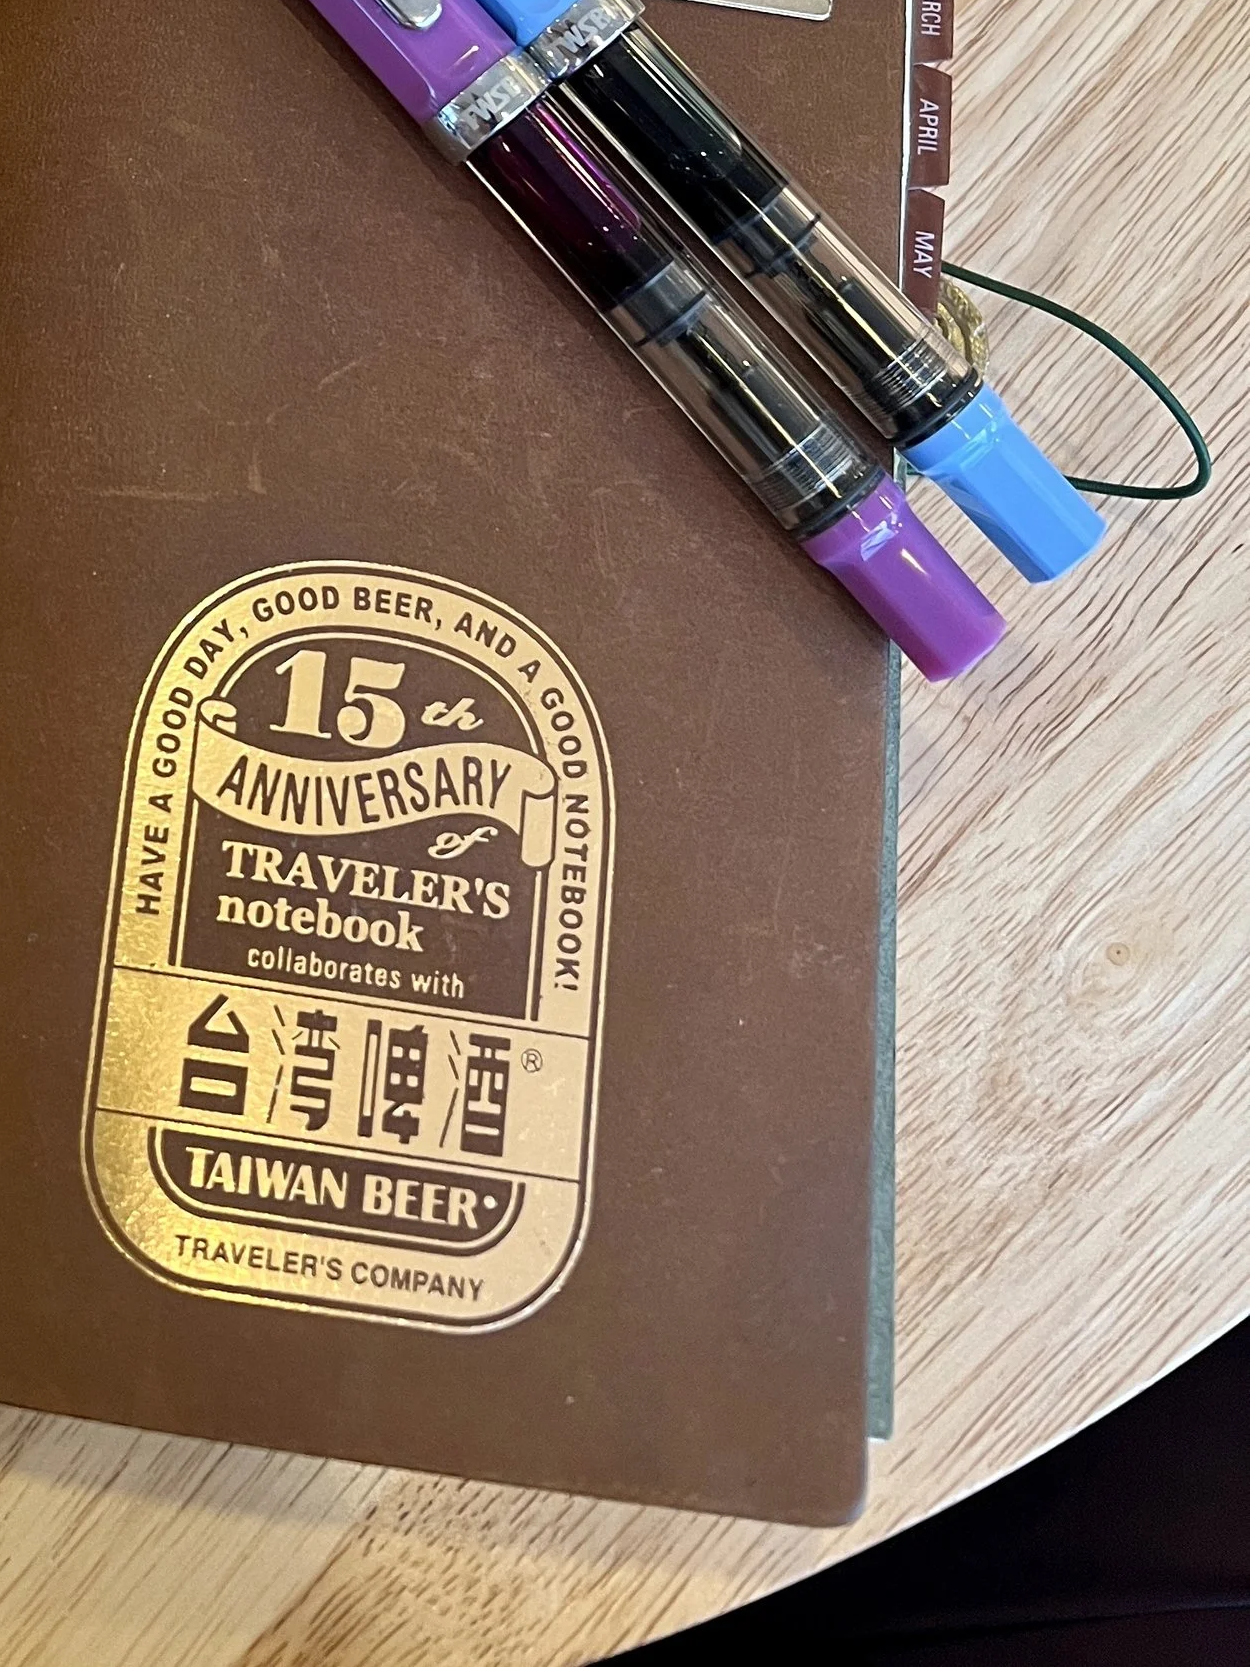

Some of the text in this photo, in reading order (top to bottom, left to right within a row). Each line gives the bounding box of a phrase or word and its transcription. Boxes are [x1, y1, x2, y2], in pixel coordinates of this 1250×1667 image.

[917, 97, 939, 156] APRIL
[913, 230, 935, 279] MAY
[136, 586, 591, 992] HAVE A GOOD DAY, GOOD BEER, AND A GOOD NOTEBOOK!
[216, 754, 513, 826] ANNIVERSARY
[428, 826, 498, 859] of
[221, 839, 511, 919] TRAVELER'S
[217, 891, 424, 953] notebook
[247, 946, 465, 999] collaborates with
[185, 1146, 348, 1210] TAIWAN
[175, 1235, 486, 1302] TRAVELER'S COMPANY
